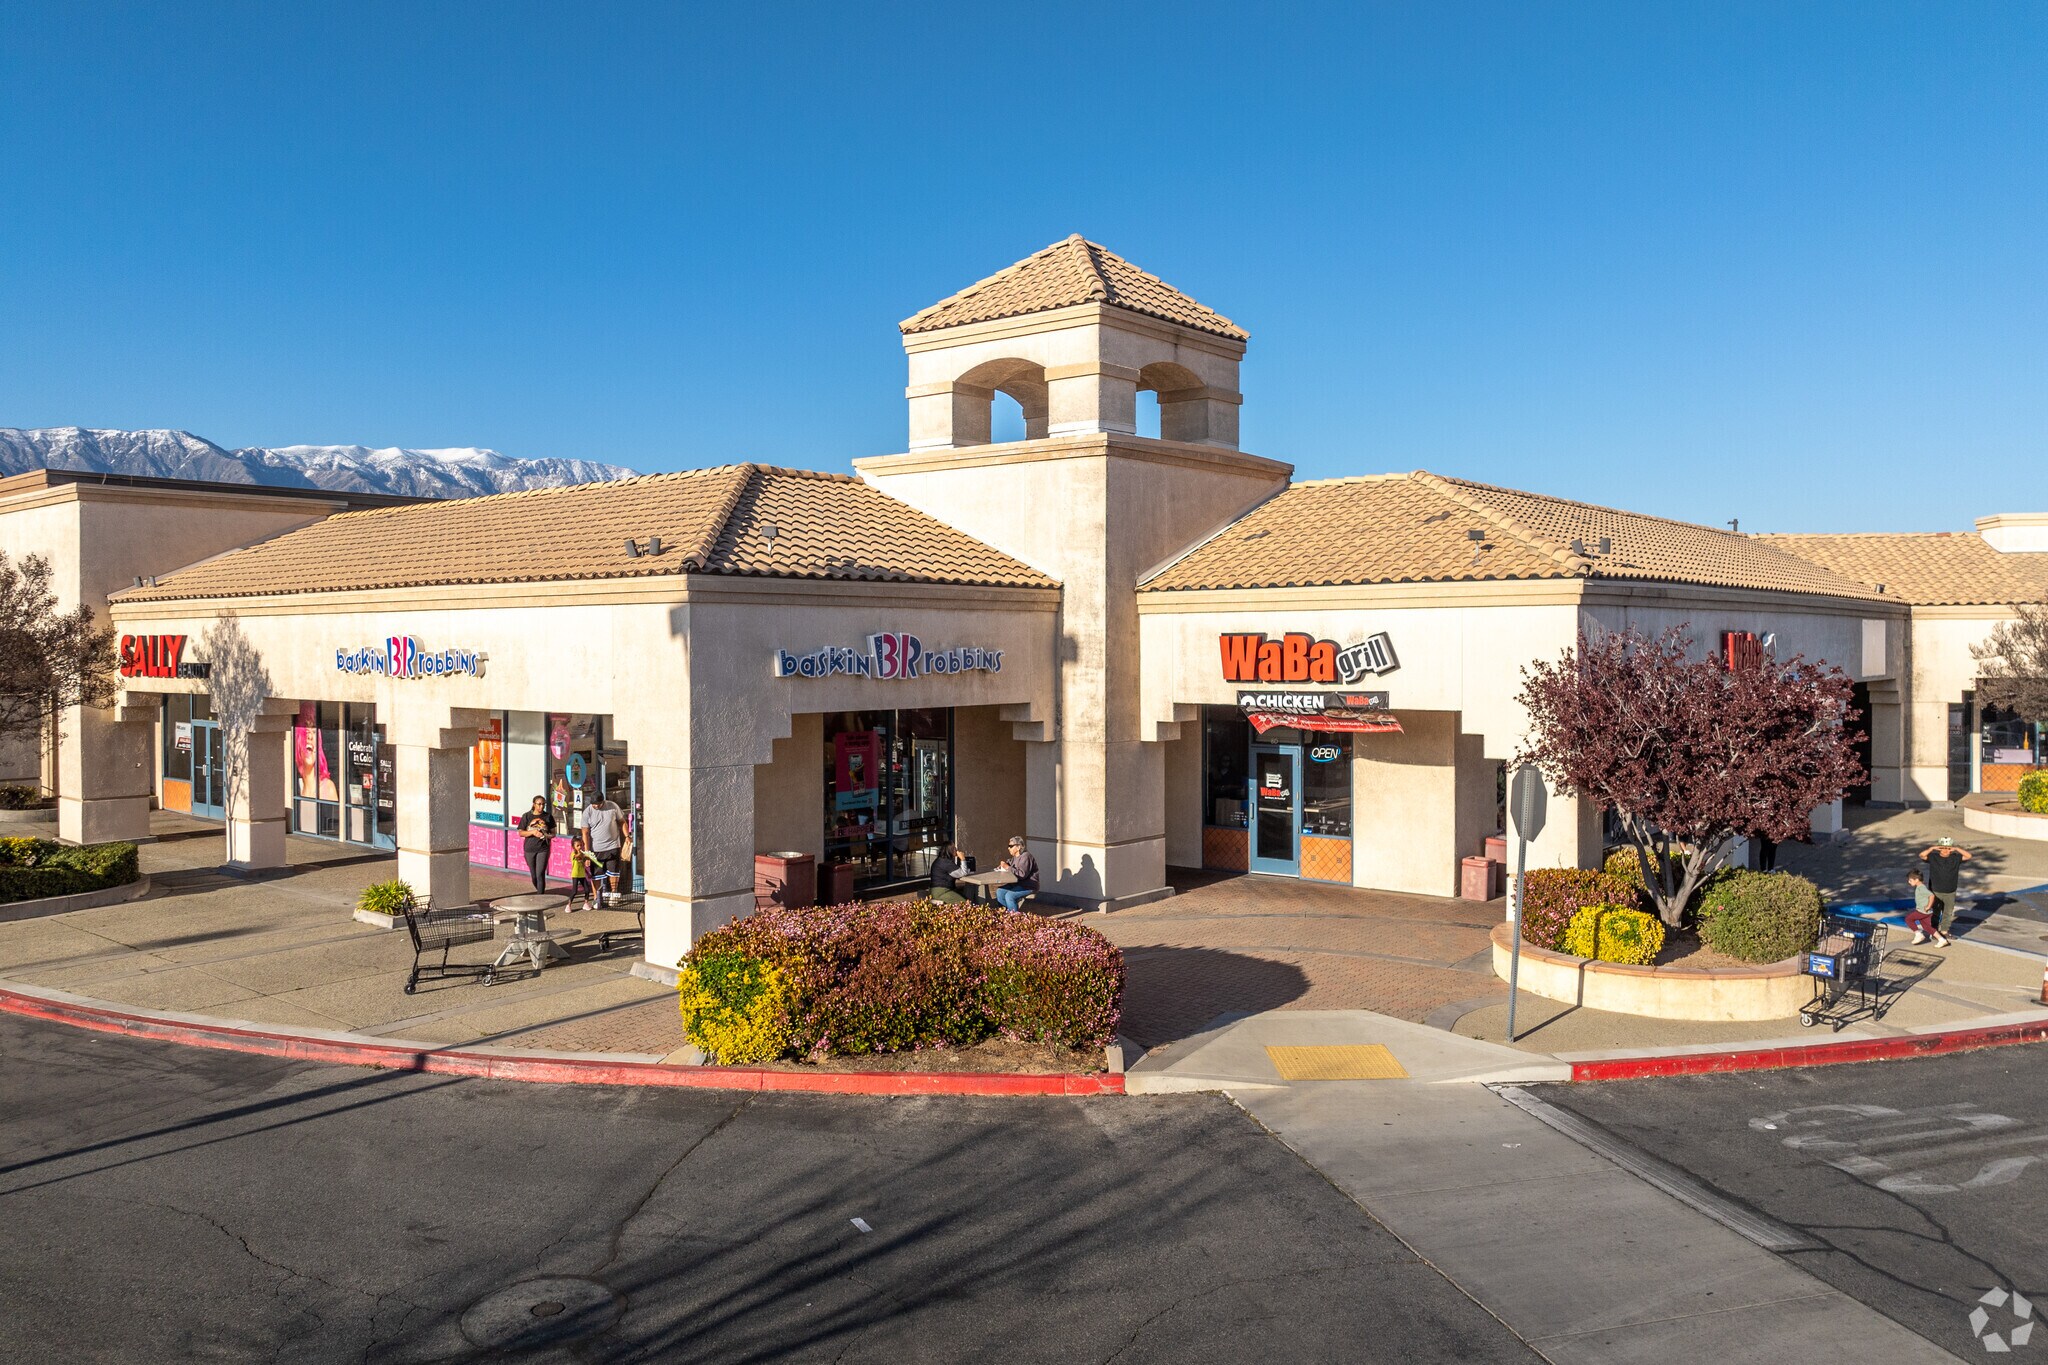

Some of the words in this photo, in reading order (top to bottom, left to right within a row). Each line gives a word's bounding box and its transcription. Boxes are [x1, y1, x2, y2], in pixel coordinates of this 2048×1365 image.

[120, 634, 183, 678] SALLY
[336, 648, 385, 673] baskin
[385, 636, 416, 676] BR
[418, 650, 478, 675] robbins
[776, 646, 871, 679] baskin
[868, 633, 923, 679] BR
[924, 650, 1004, 674] robbins
[1219, 635, 1335, 682] WaBa
[1337, 636, 1391, 681] grill
[1256, 695, 1325, 709] CHICKEN
[1346, 695, 1369, 706] WaBa
[353, 753, 359, 762] in
[1311, 748, 1339, 760] OPEN
[576, 795, 581, 803] A
